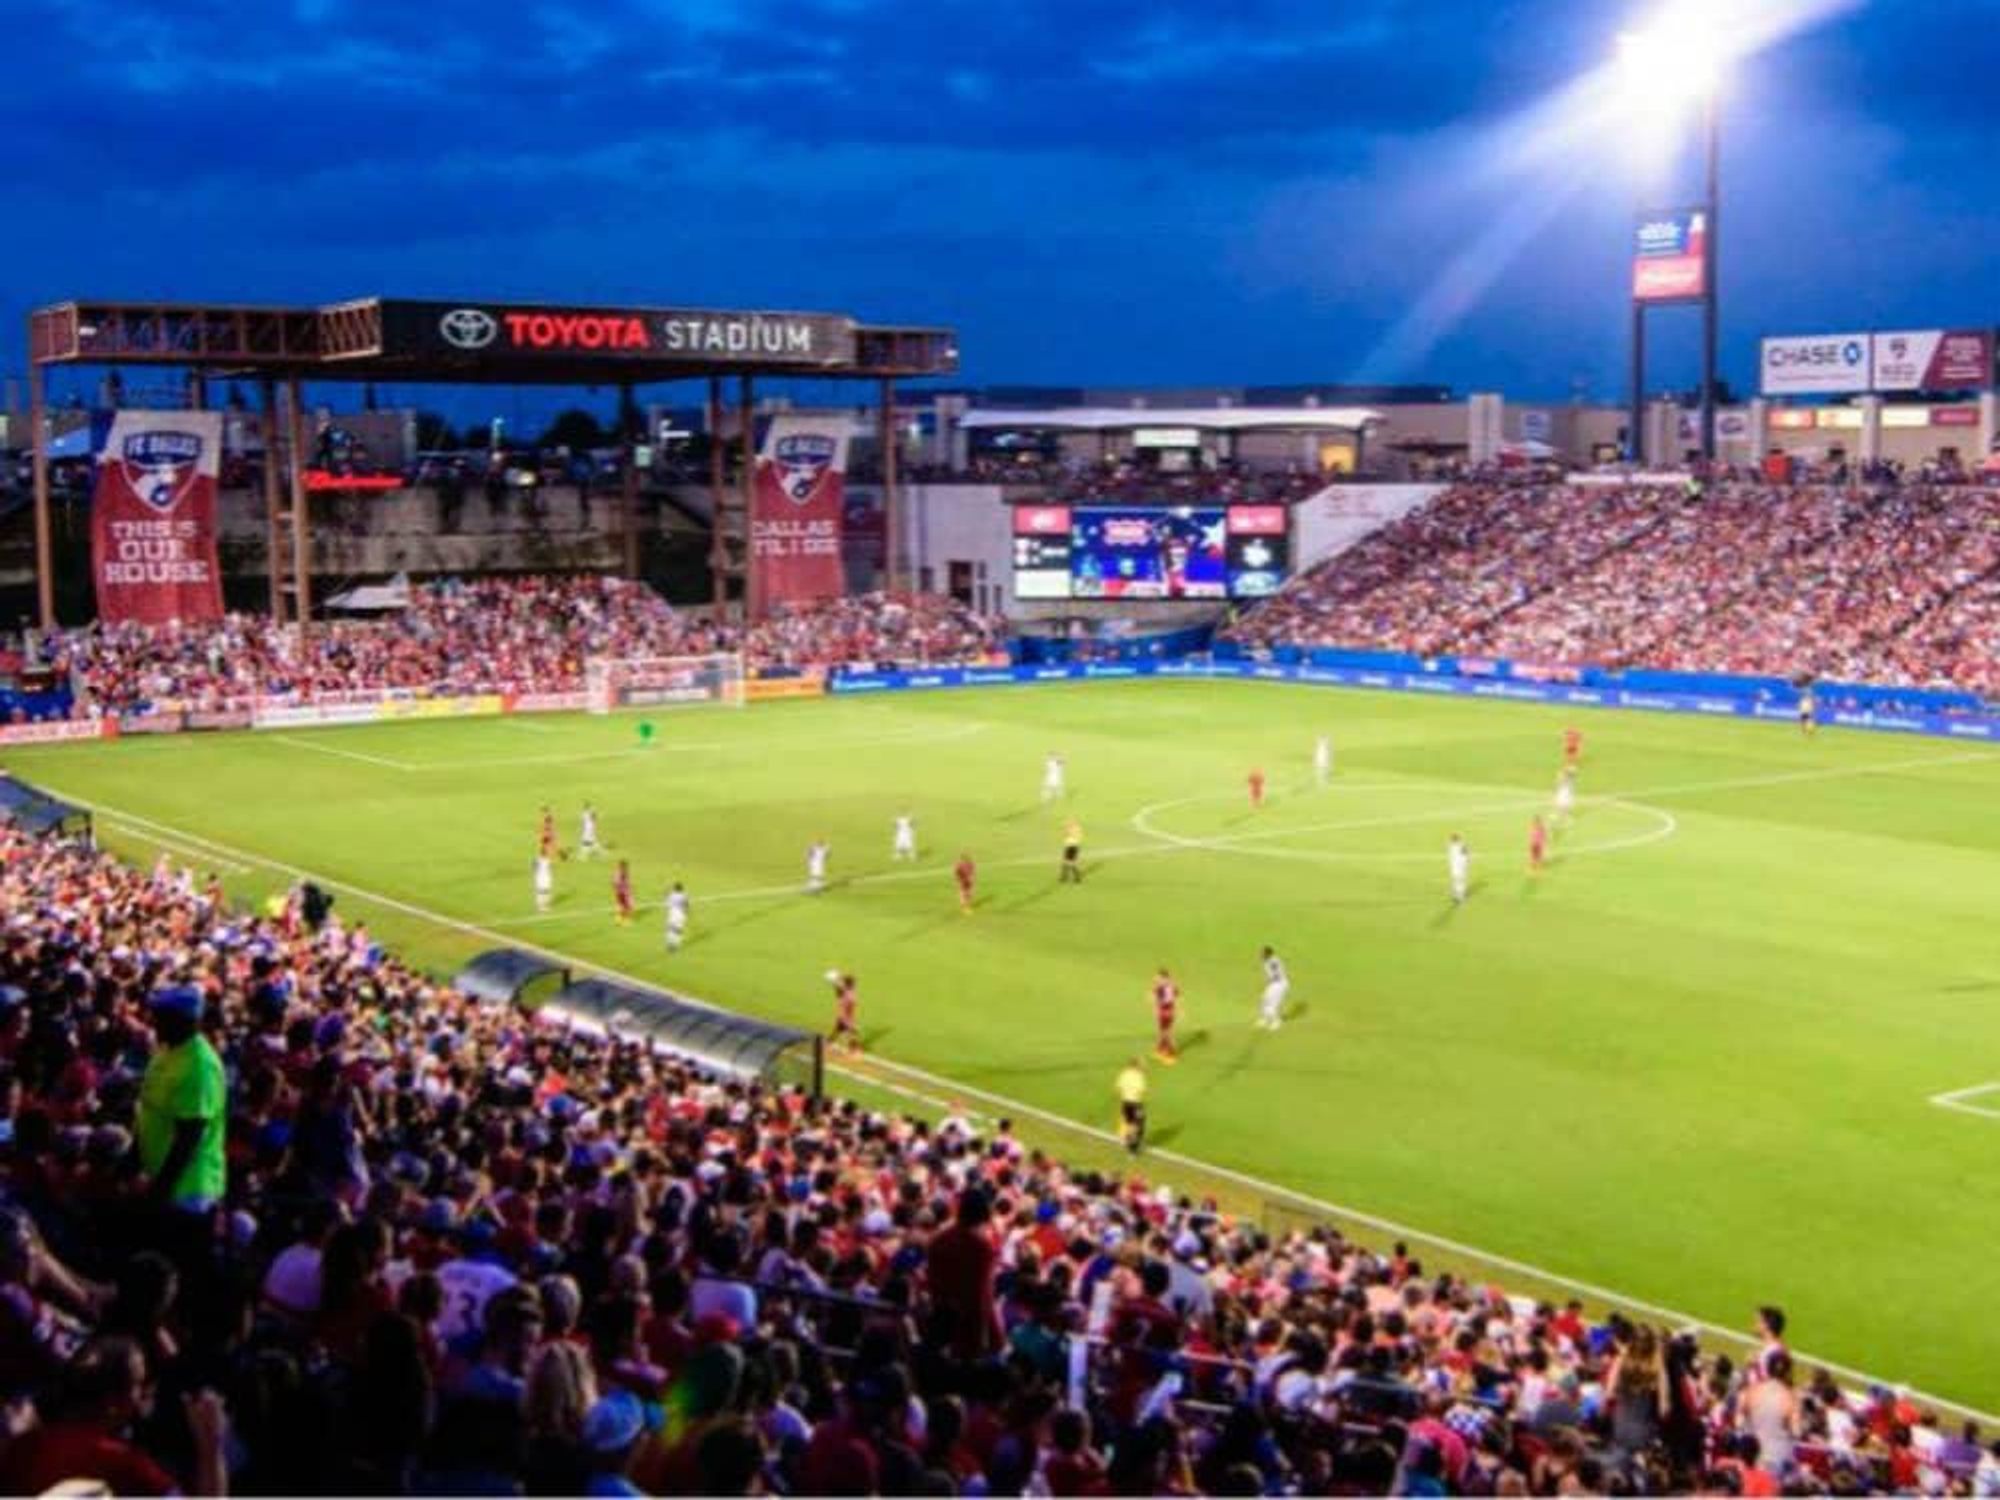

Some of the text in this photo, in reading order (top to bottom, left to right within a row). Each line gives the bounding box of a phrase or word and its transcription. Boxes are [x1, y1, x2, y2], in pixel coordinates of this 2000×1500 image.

[504, 315, 811, 351] TOYOTA STADIUM
[1768, 344, 1838, 367] CHASE
